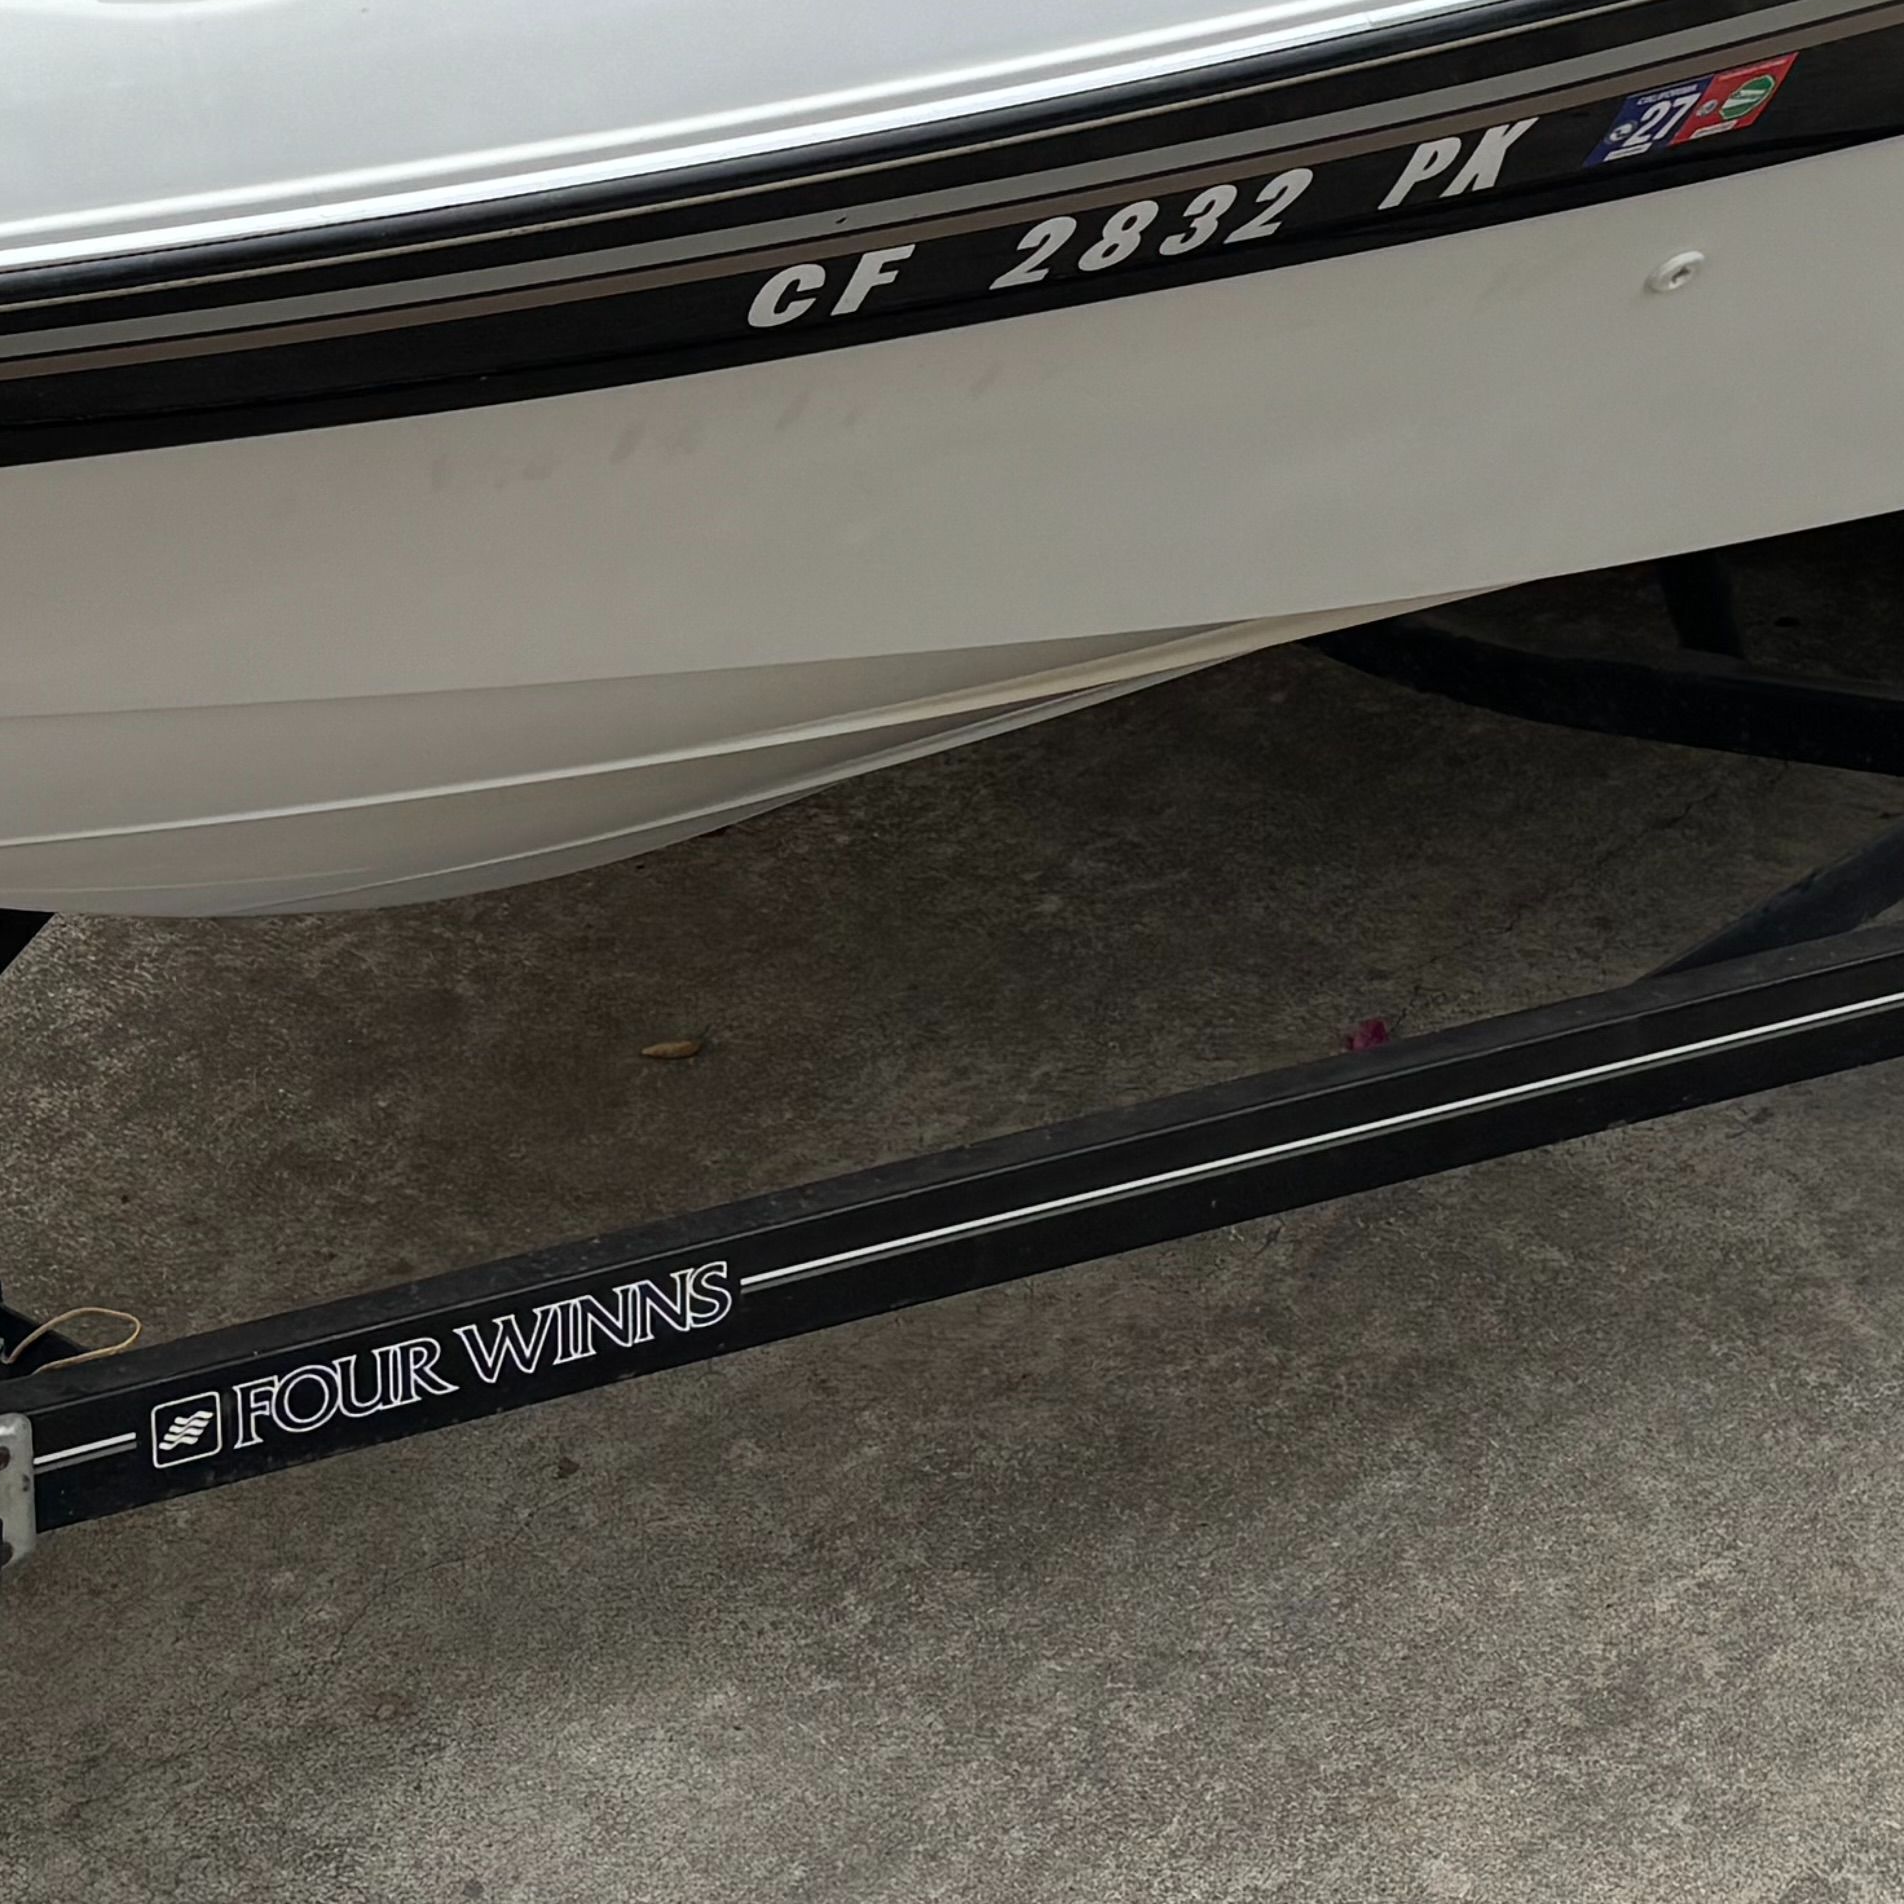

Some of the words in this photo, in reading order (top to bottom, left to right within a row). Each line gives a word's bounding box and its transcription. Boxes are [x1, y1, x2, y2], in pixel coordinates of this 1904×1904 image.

[1622, 93, 1702, 147] 27
[747, 243, 917, 328] CF
[989, 168, 1314, 291] 2832
[1377, 116, 1540, 210] PK
[234, 1337, 459, 1449] FOUR
[453, 1261, 734, 1384] WINNS
